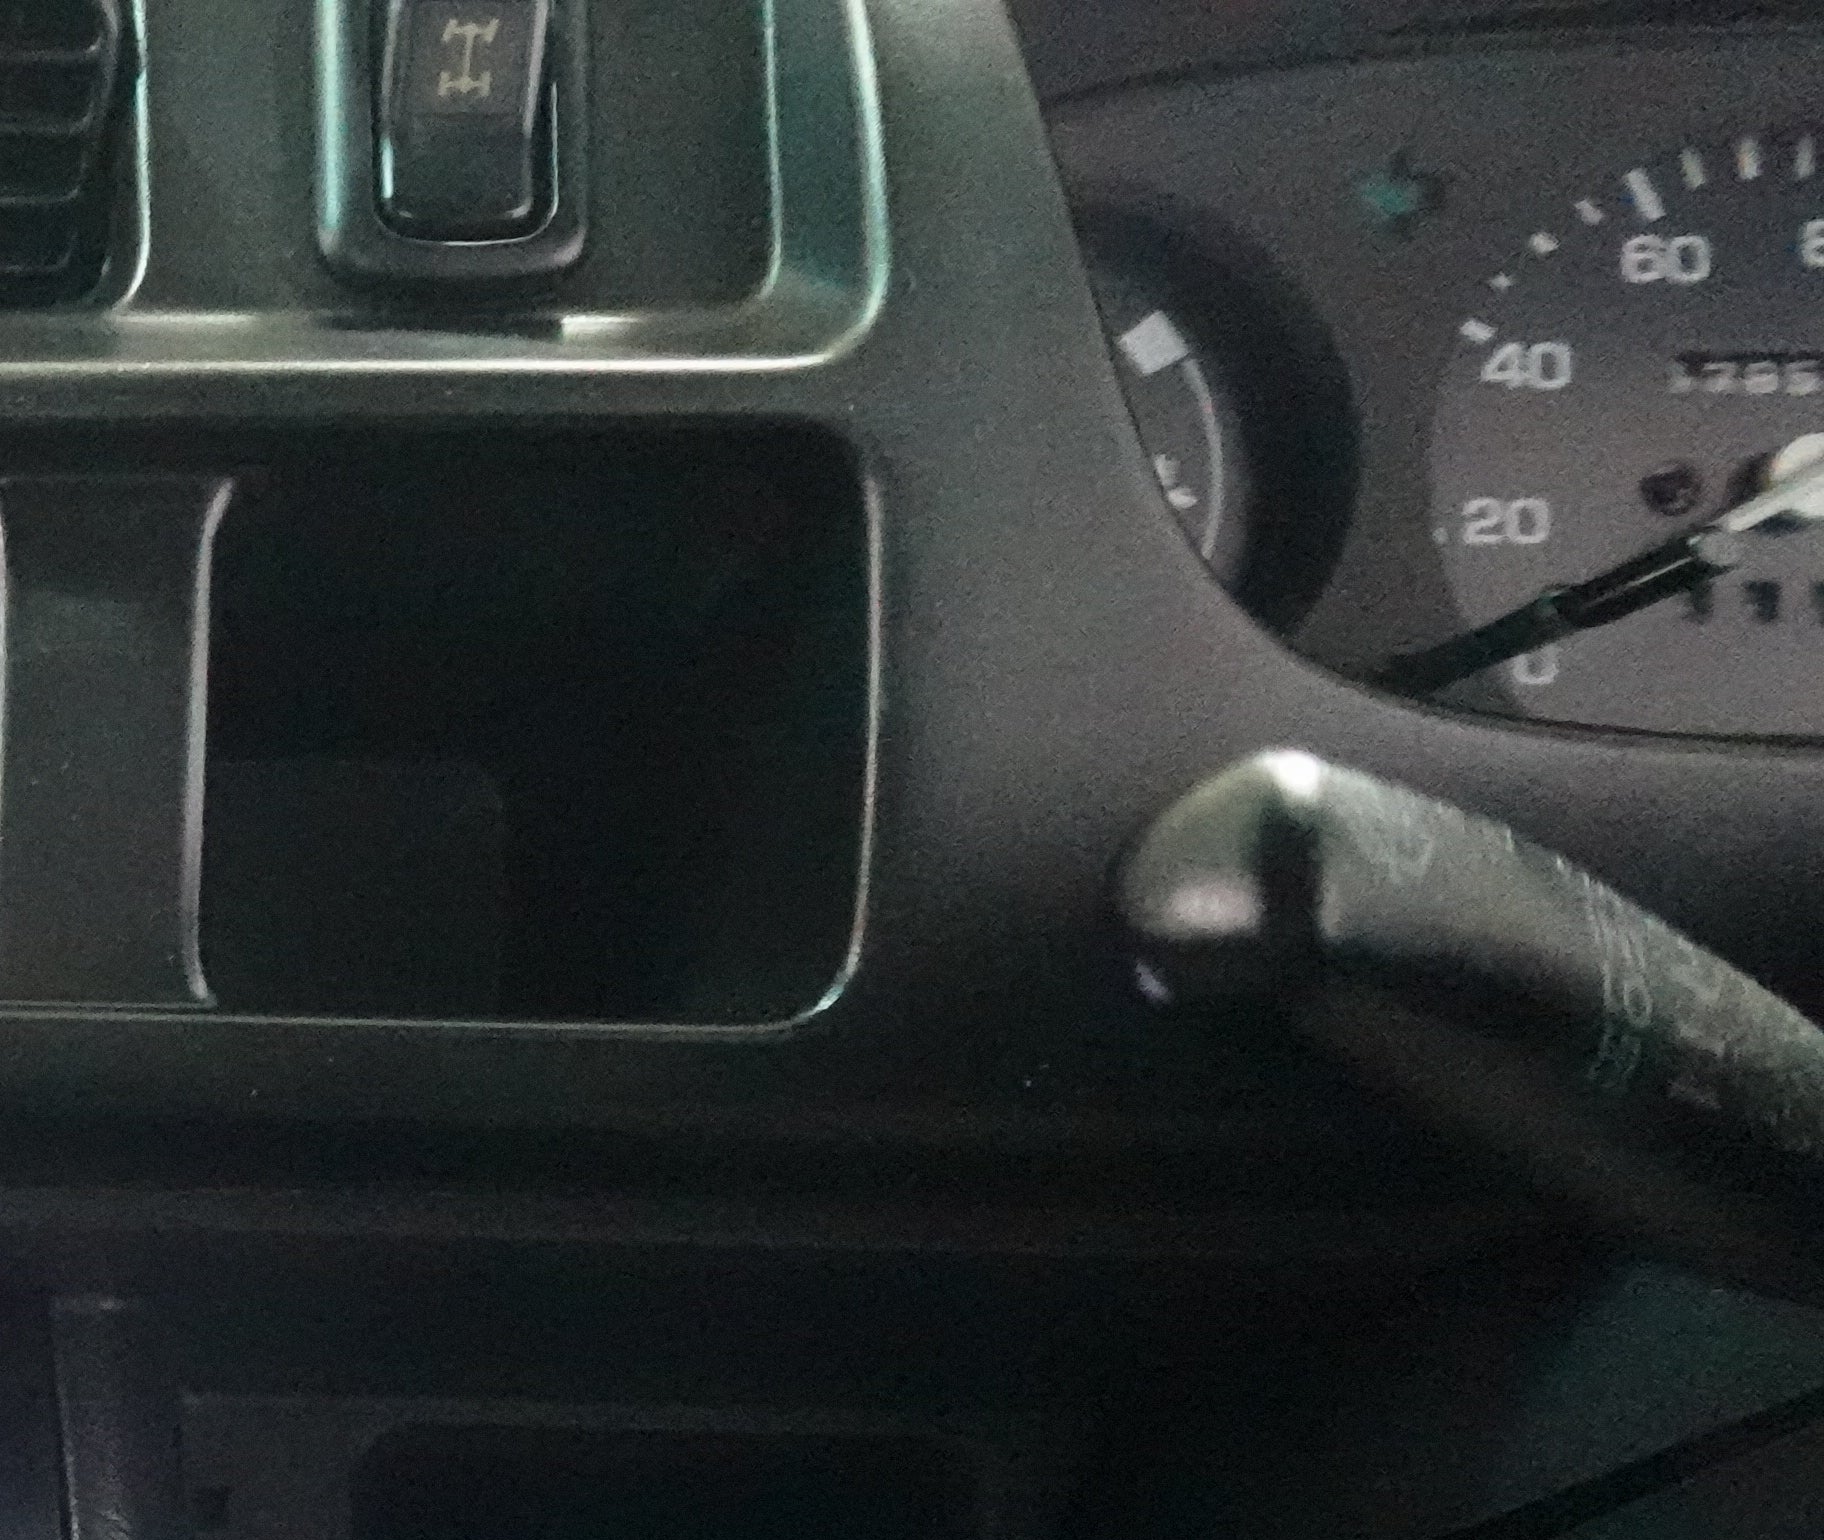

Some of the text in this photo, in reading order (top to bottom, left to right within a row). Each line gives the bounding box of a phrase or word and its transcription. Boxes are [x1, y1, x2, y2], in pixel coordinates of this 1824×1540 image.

[1620, 235, 1711, 284] 60
[1481, 342, 1572, 389] 40
[1462, 497, 1551, 544] 20
